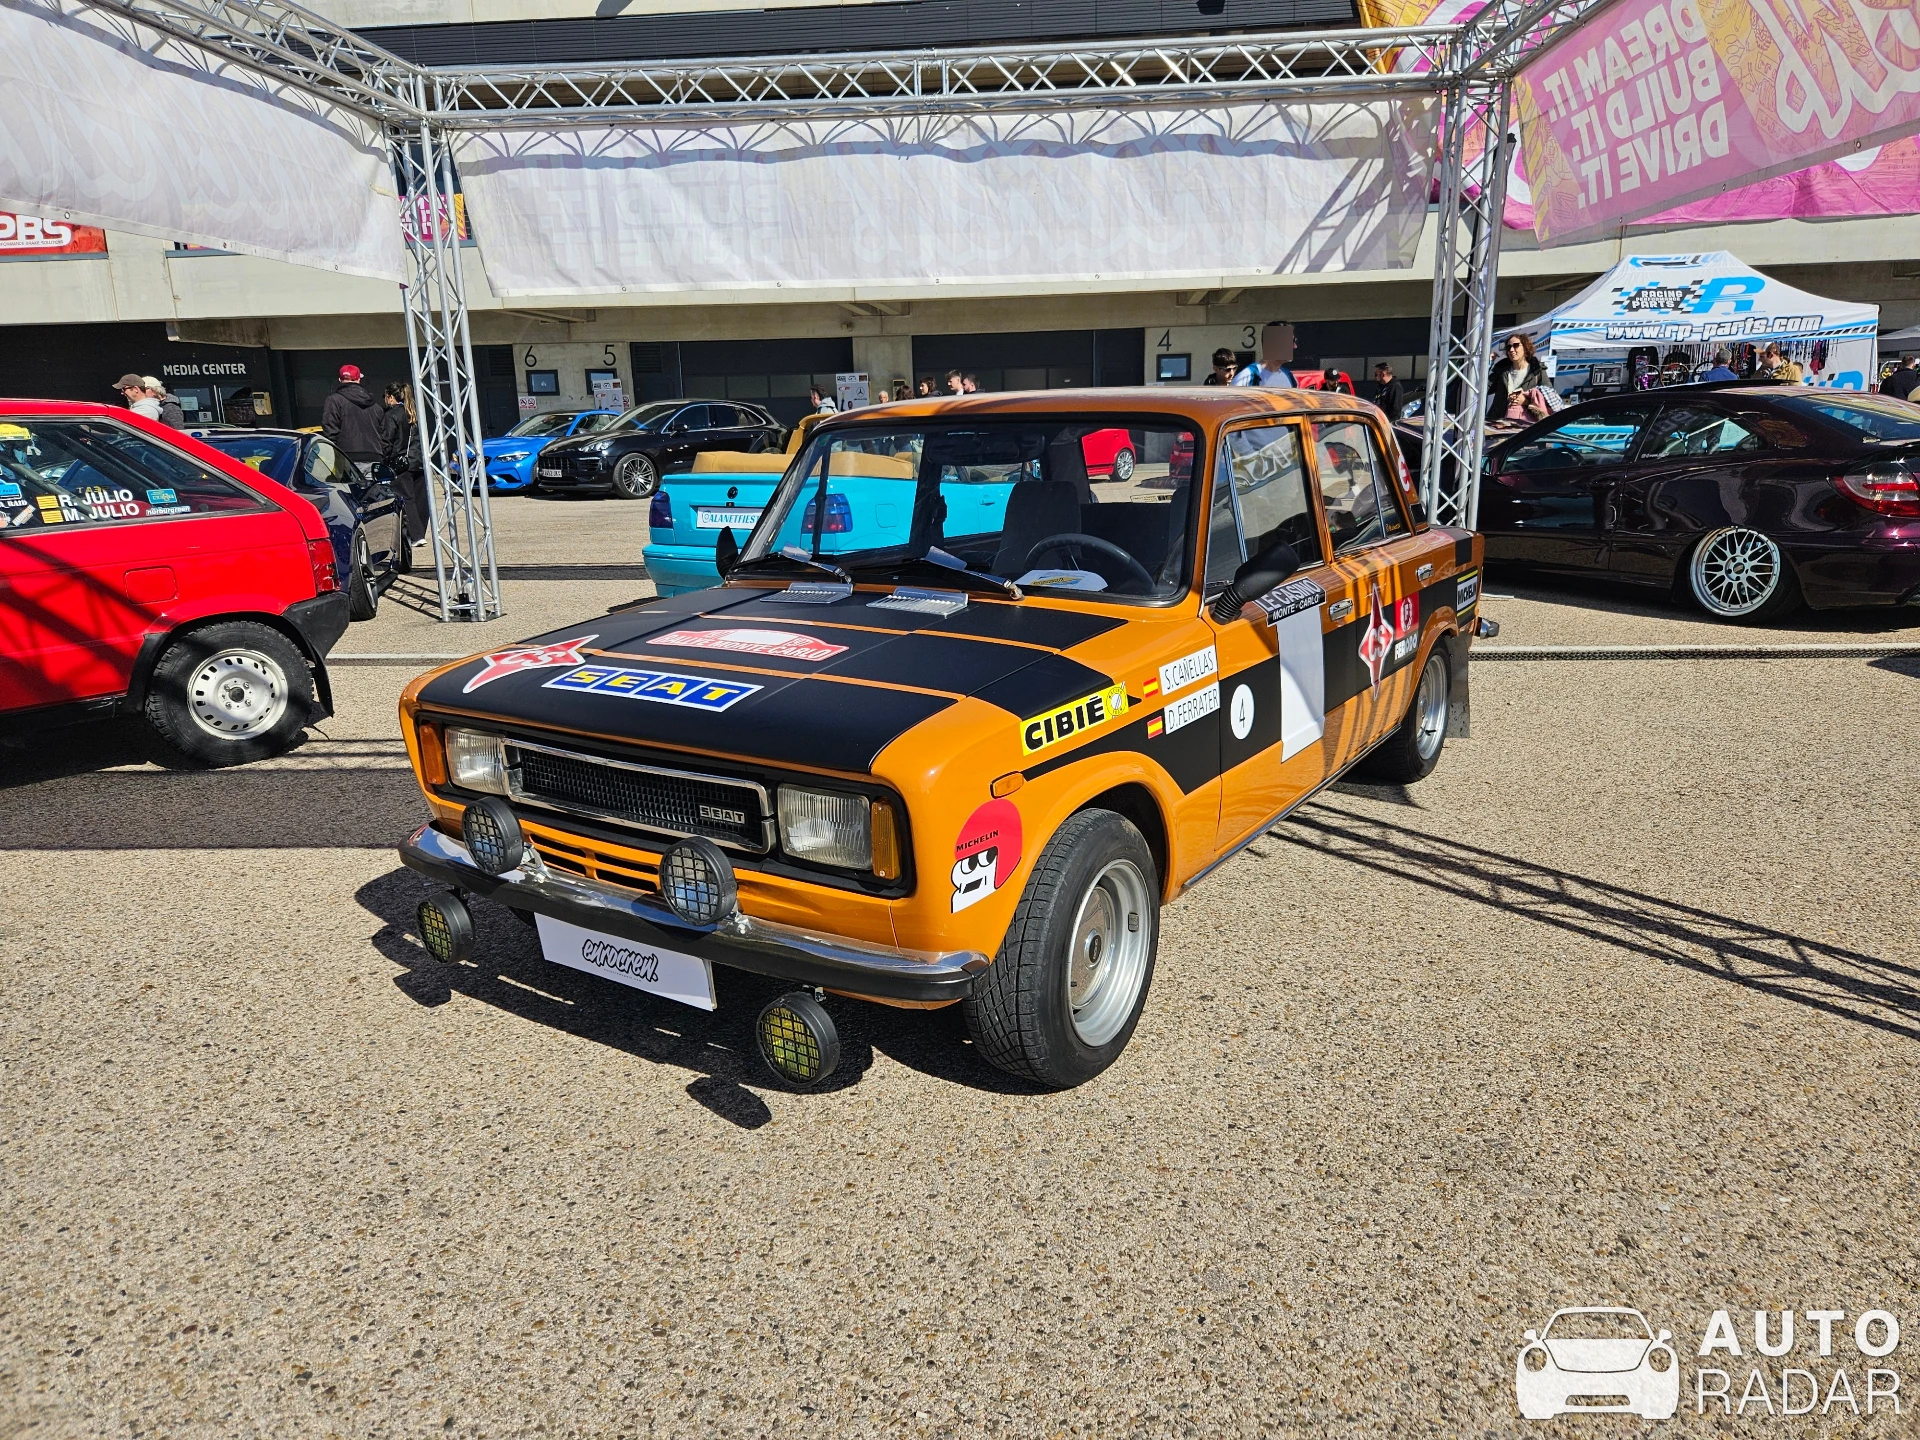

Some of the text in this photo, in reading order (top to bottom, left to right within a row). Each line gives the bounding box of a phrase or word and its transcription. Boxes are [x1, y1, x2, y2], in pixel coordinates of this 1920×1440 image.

[1632, 301, 1675, 309] PARTS
[1641, 290, 1683, 298] RACING
[1241, 325, 1256, 349] 3
[1607, 315, 1824, 342] www.rp-parts.com
[1157, 329, 1172, 351] 4
[524, 345, 537, 367] 6
[603, 344, 617, 366] 5
[163, 363, 247, 376] MEDIA CENTER
[58, 494, 78, 507] R.
[82, 489, 134, 506] JULIO
[63, 503, 140, 522] M. JULIO
[1255, 579, 1321, 613] LE CASINO
[1368, 624, 1386, 662] CS
[499, 649, 561, 667] CS
[563, 669, 743, 701] SEAT
[1168, 688, 1219, 731] D.FERRATER
[1239, 698, 1246, 729] 4
[700, 804, 745, 824] SEAT
[956, 829, 999, 852] MICHELIN
